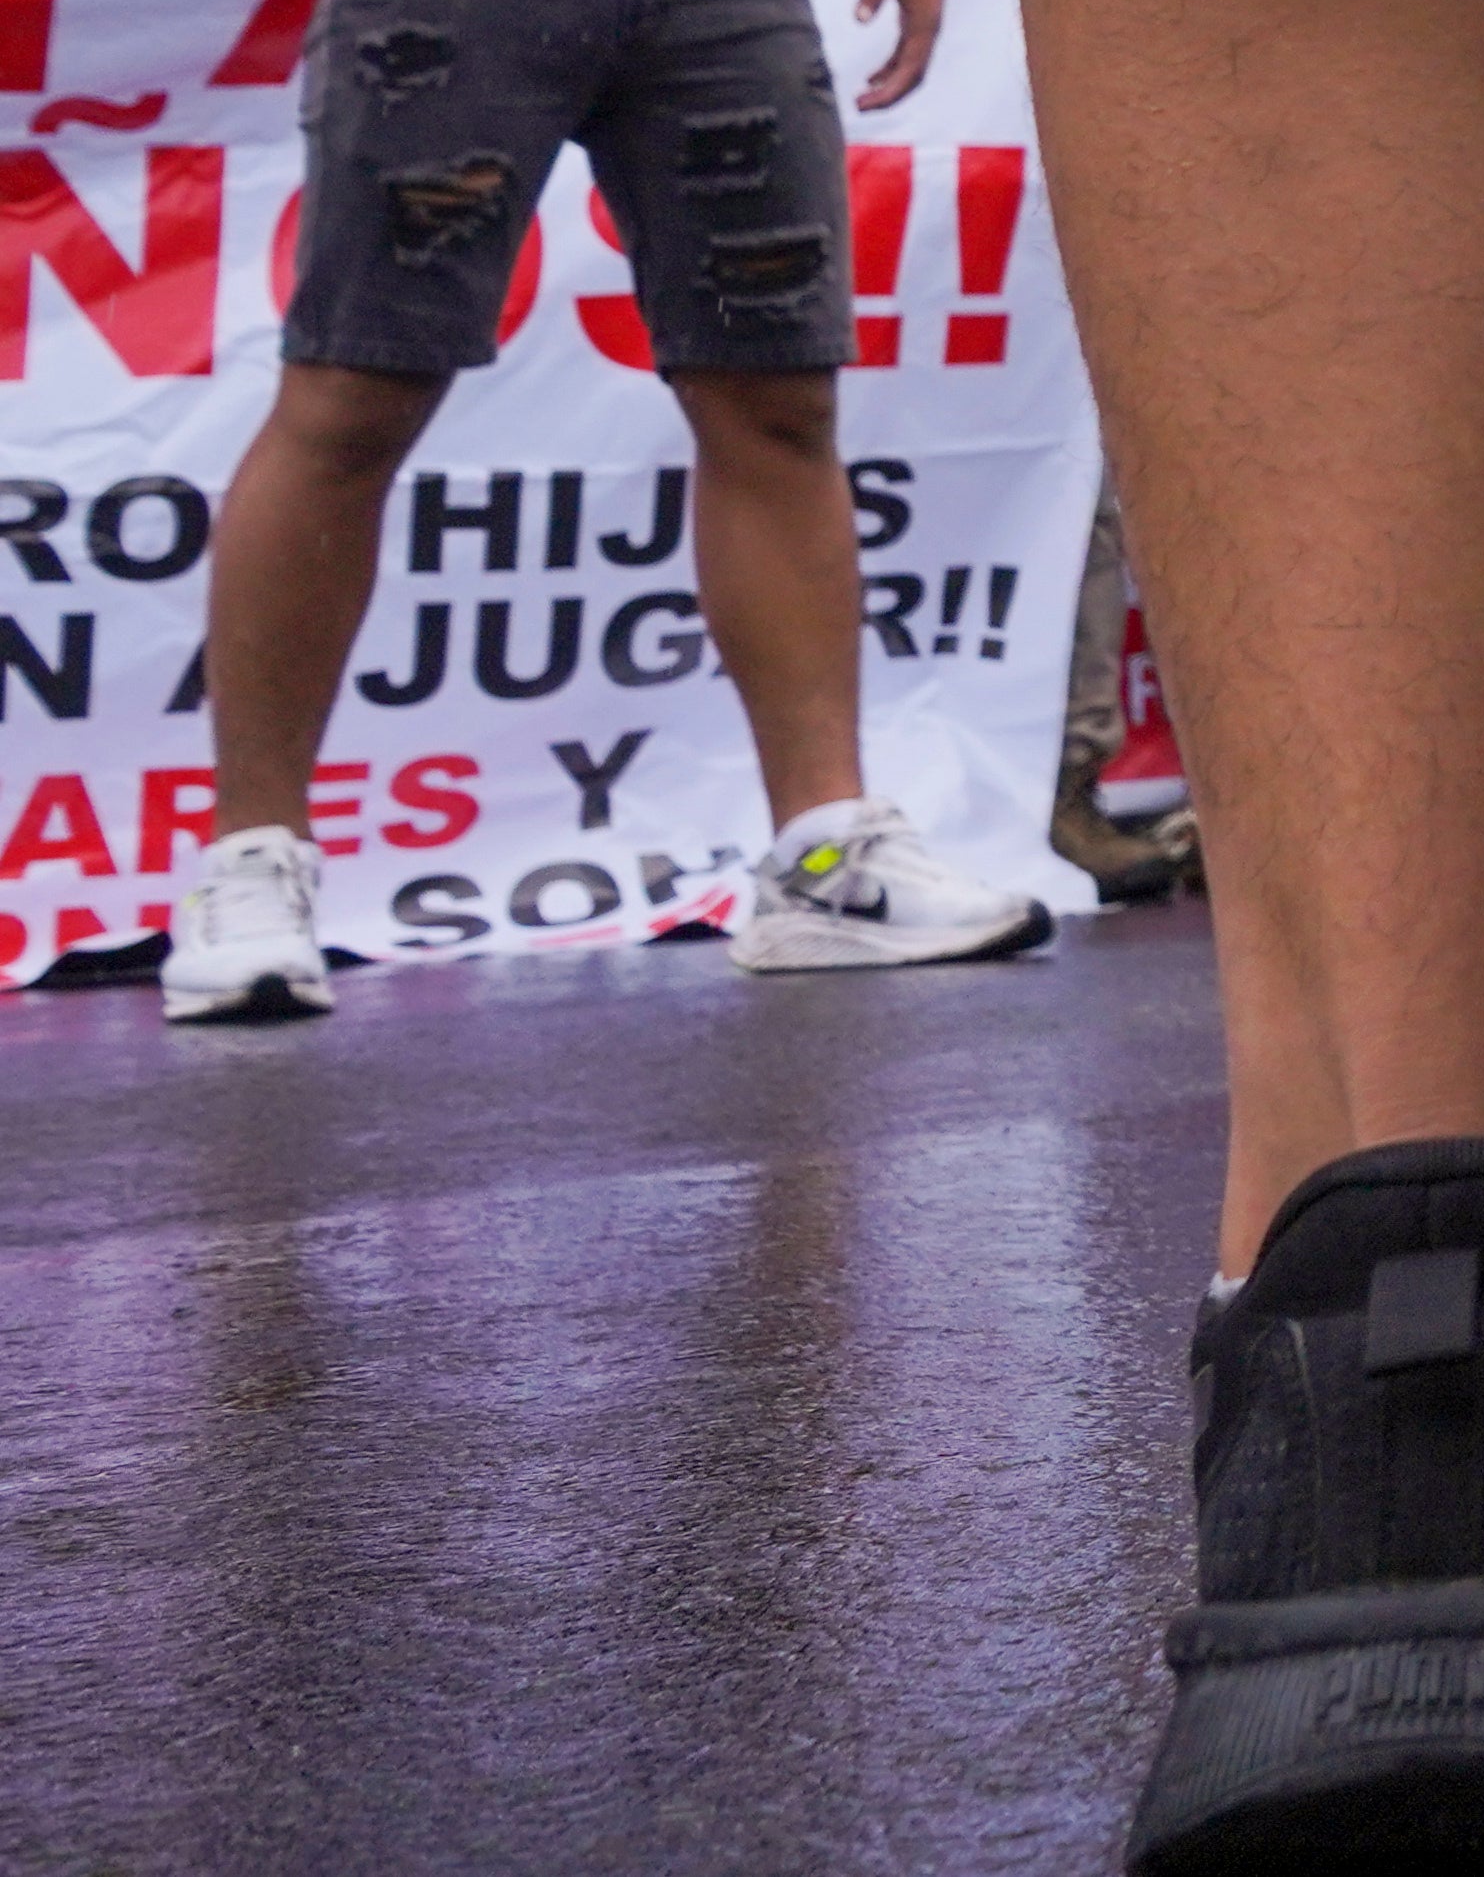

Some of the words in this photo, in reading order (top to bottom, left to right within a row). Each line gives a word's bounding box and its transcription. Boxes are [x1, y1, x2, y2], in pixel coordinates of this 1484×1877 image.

[408, 457, 917, 573] HIJS
[355, 565, 1018, 707] JUGR!!
[549, 728, 650, 830] Y
